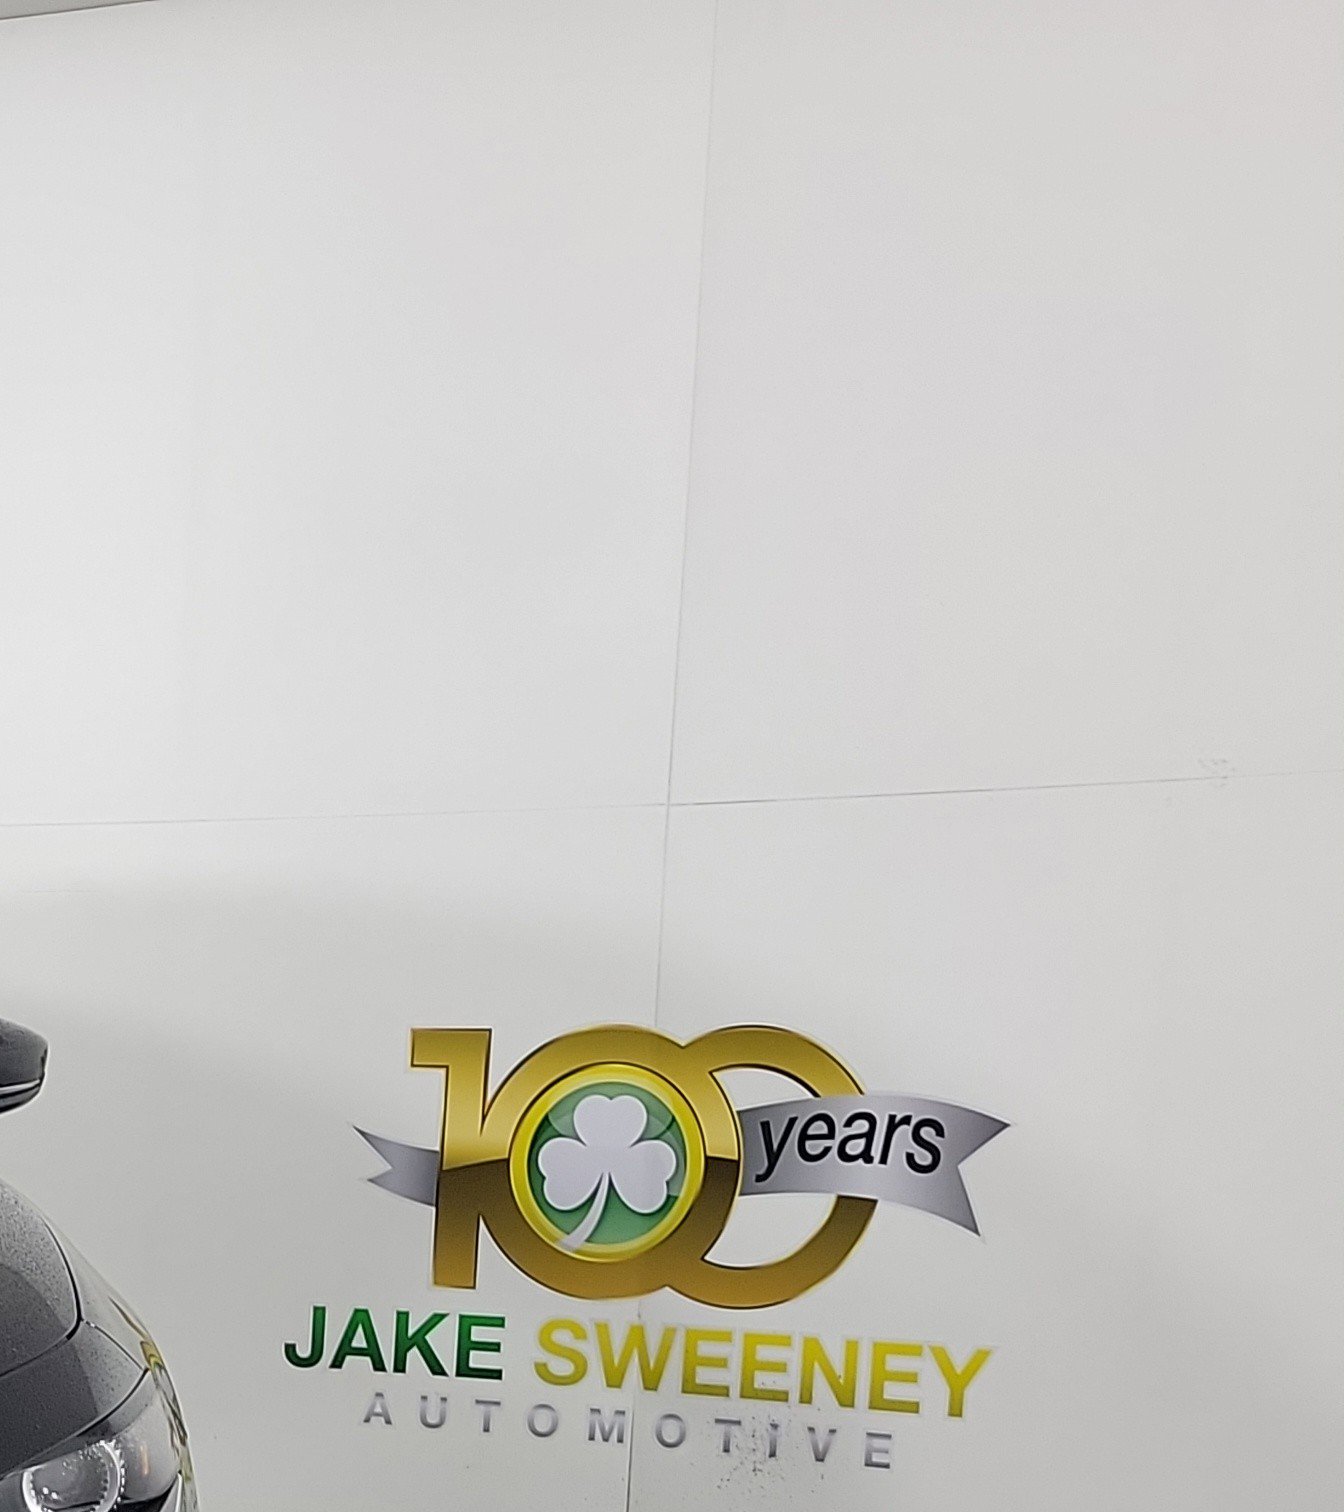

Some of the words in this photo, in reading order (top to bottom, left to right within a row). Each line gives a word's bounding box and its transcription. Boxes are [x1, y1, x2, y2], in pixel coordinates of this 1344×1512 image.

[411, 1024, 879, 1310] 100
[754, 1110, 946, 1183] years
[283, 1305, 507, 1382] JAKE
[533, 1317, 991, 1419] SWEENEY
[363, 1392, 893, 1469] AUTOMOTIVE
